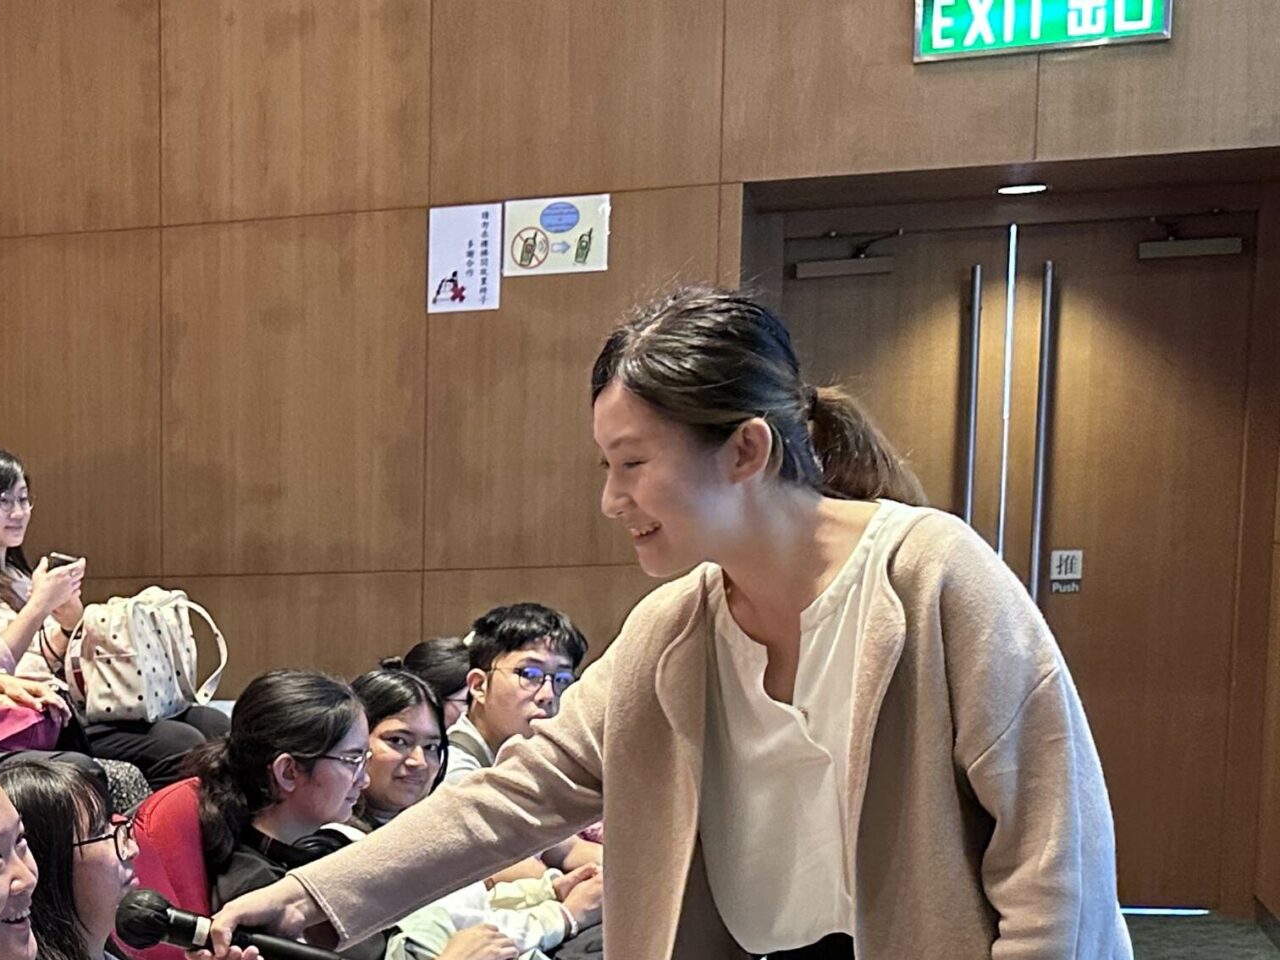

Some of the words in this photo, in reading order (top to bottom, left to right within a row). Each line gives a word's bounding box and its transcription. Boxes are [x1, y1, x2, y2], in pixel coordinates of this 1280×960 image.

[931, 0, 1043, 49] EXIT
[466, 240, 474, 277] 多謝合作
[1056, 554, 1078, 576] 推
[1052, 582, 1079, 592] Push
